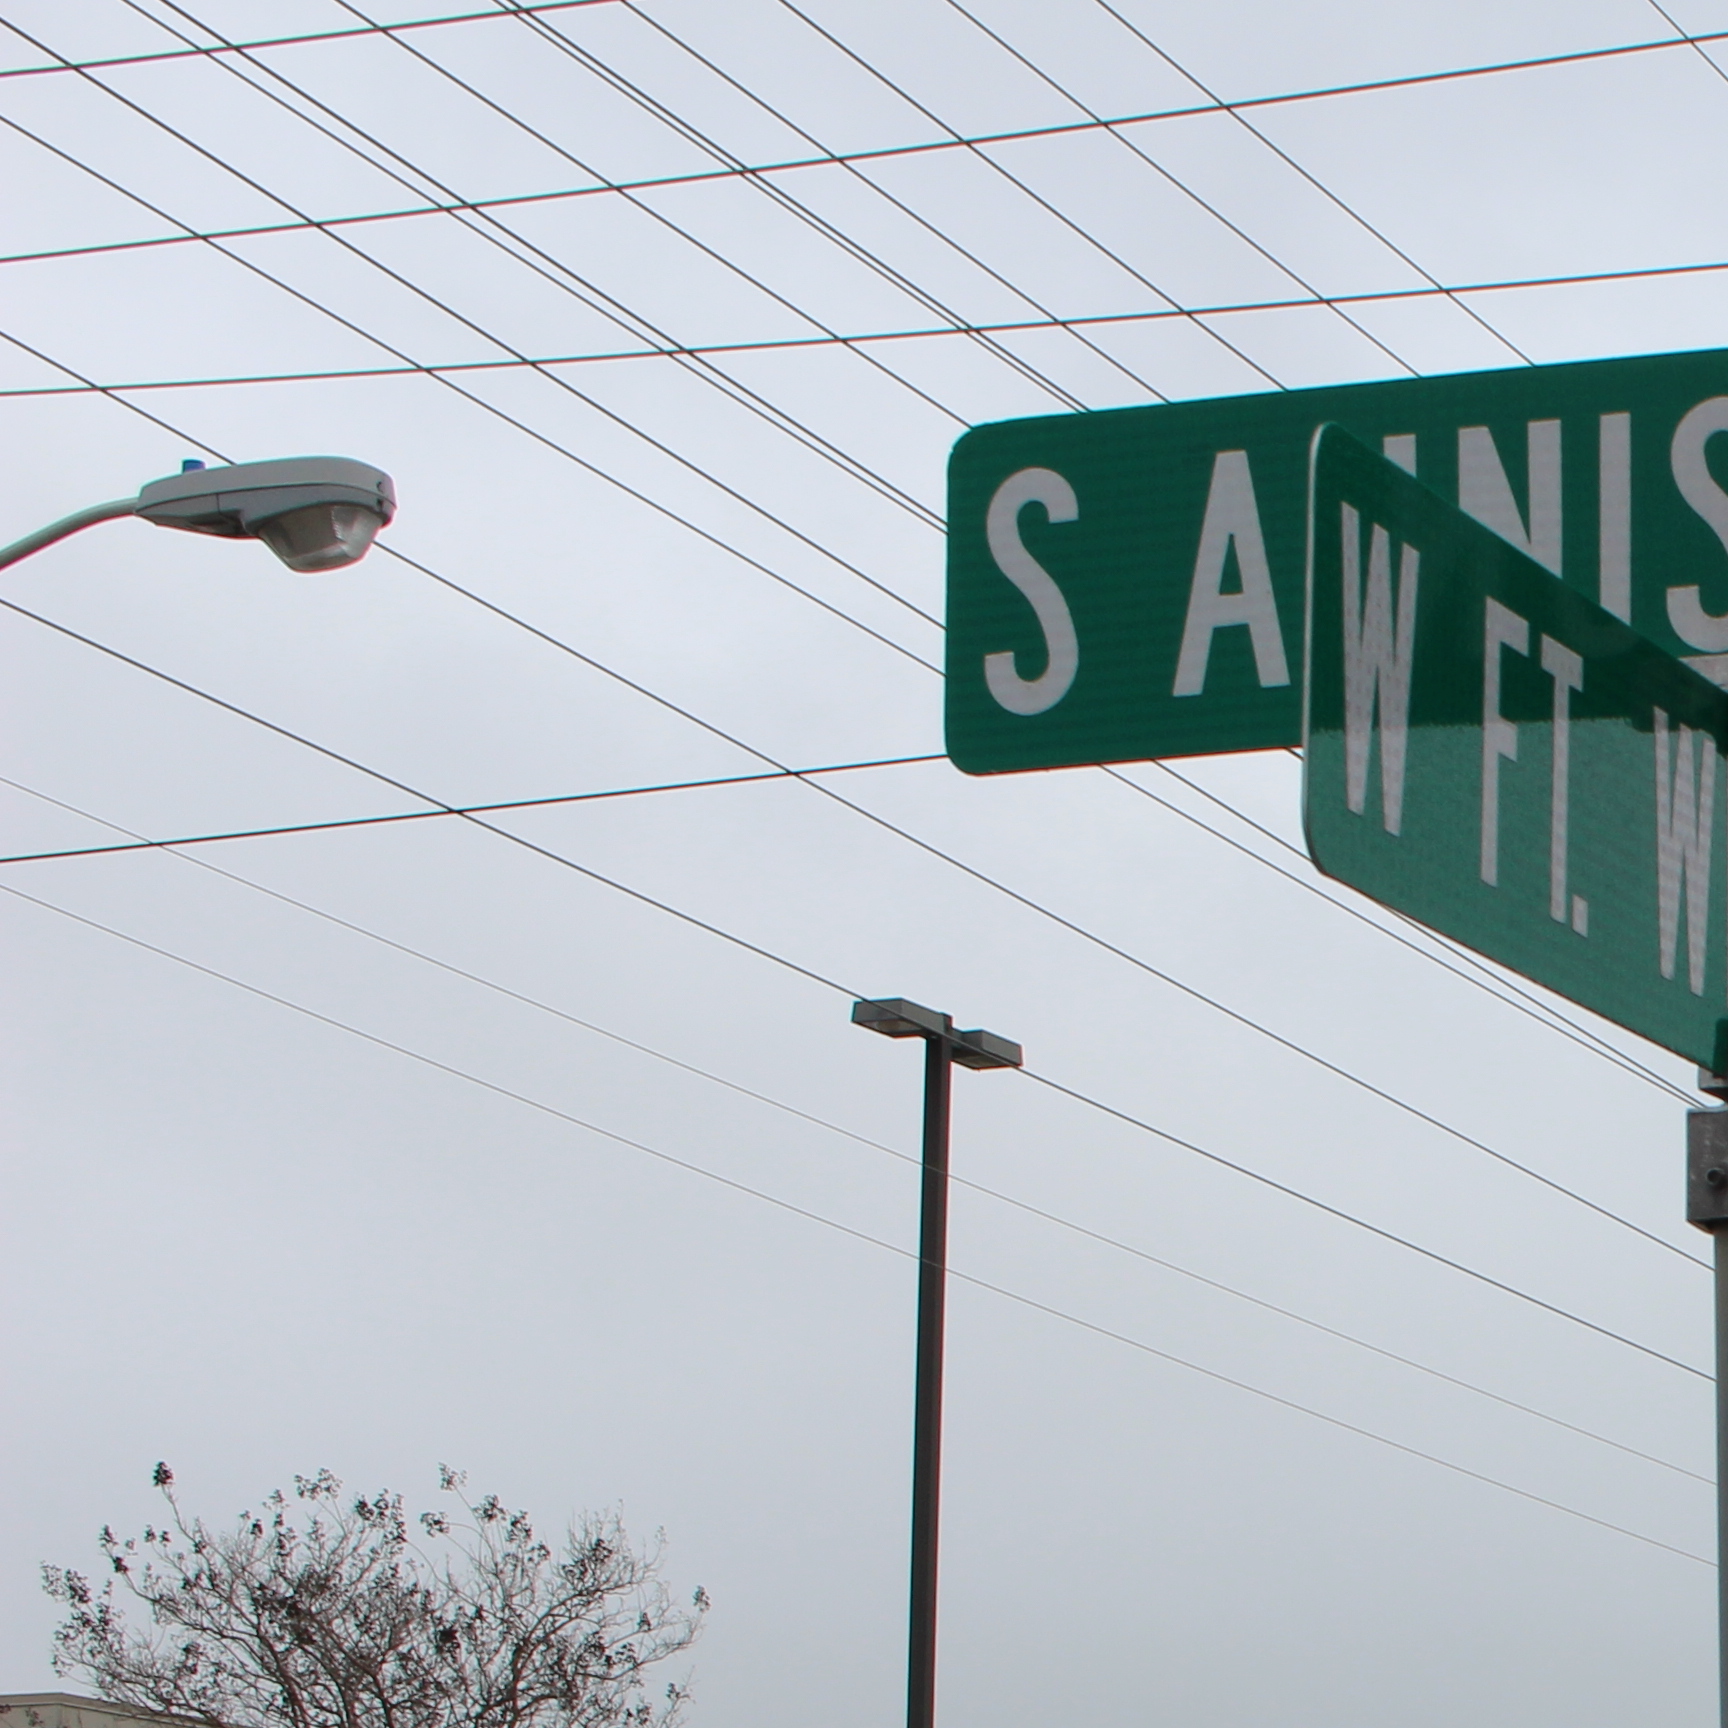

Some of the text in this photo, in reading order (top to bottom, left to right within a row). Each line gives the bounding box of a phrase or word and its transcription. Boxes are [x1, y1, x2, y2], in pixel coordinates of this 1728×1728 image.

[984, 467, 1079, 716] S
[1340, 500, 1421, 838] W
[1480, 596, 1589, 938] FT.
